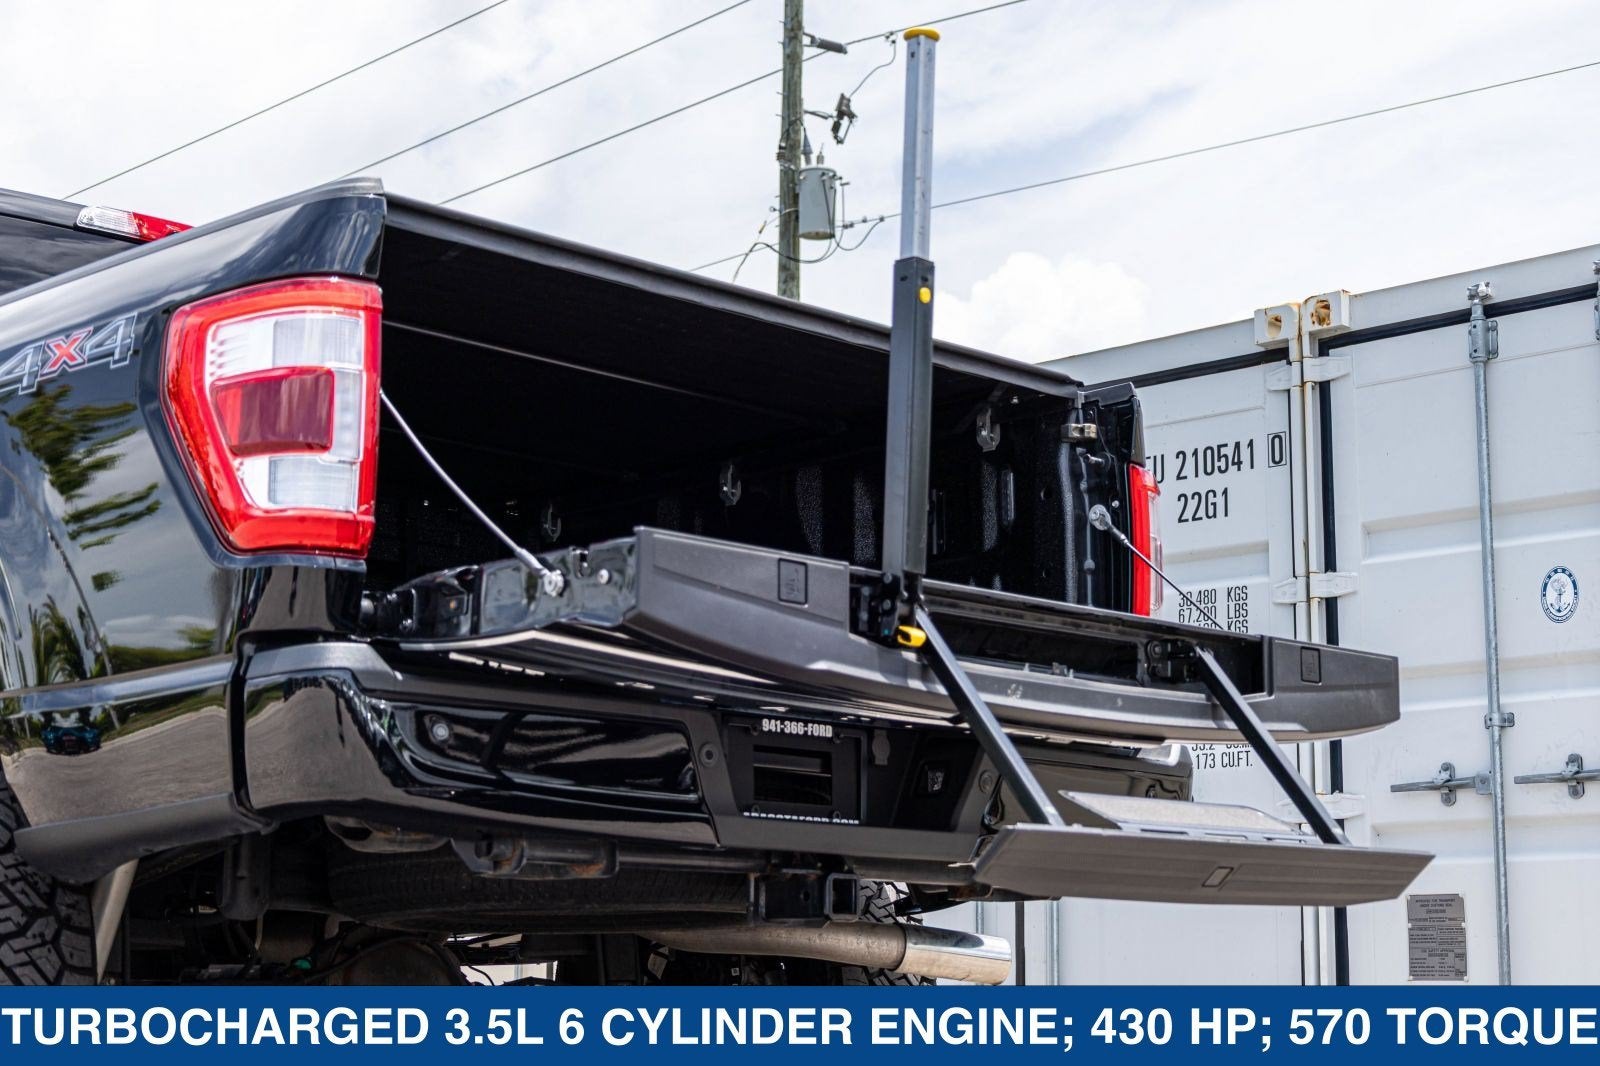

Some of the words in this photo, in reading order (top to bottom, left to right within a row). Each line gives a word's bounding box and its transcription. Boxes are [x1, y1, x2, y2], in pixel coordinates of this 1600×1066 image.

[1175, 438, 1255, 481] 210541
[1270, 434, 1284, 465] 0
[1177, 487, 1229, 523] 22G1
[1178, 588, 1217, 608] 30480
[1226, 585, 1248, 603] KGS
[1226, 602, 1249, 620] LBS
[762, 718, 833, 738] 941-366-FORD
[1221, 750, 1253, 768] CU.FT.
